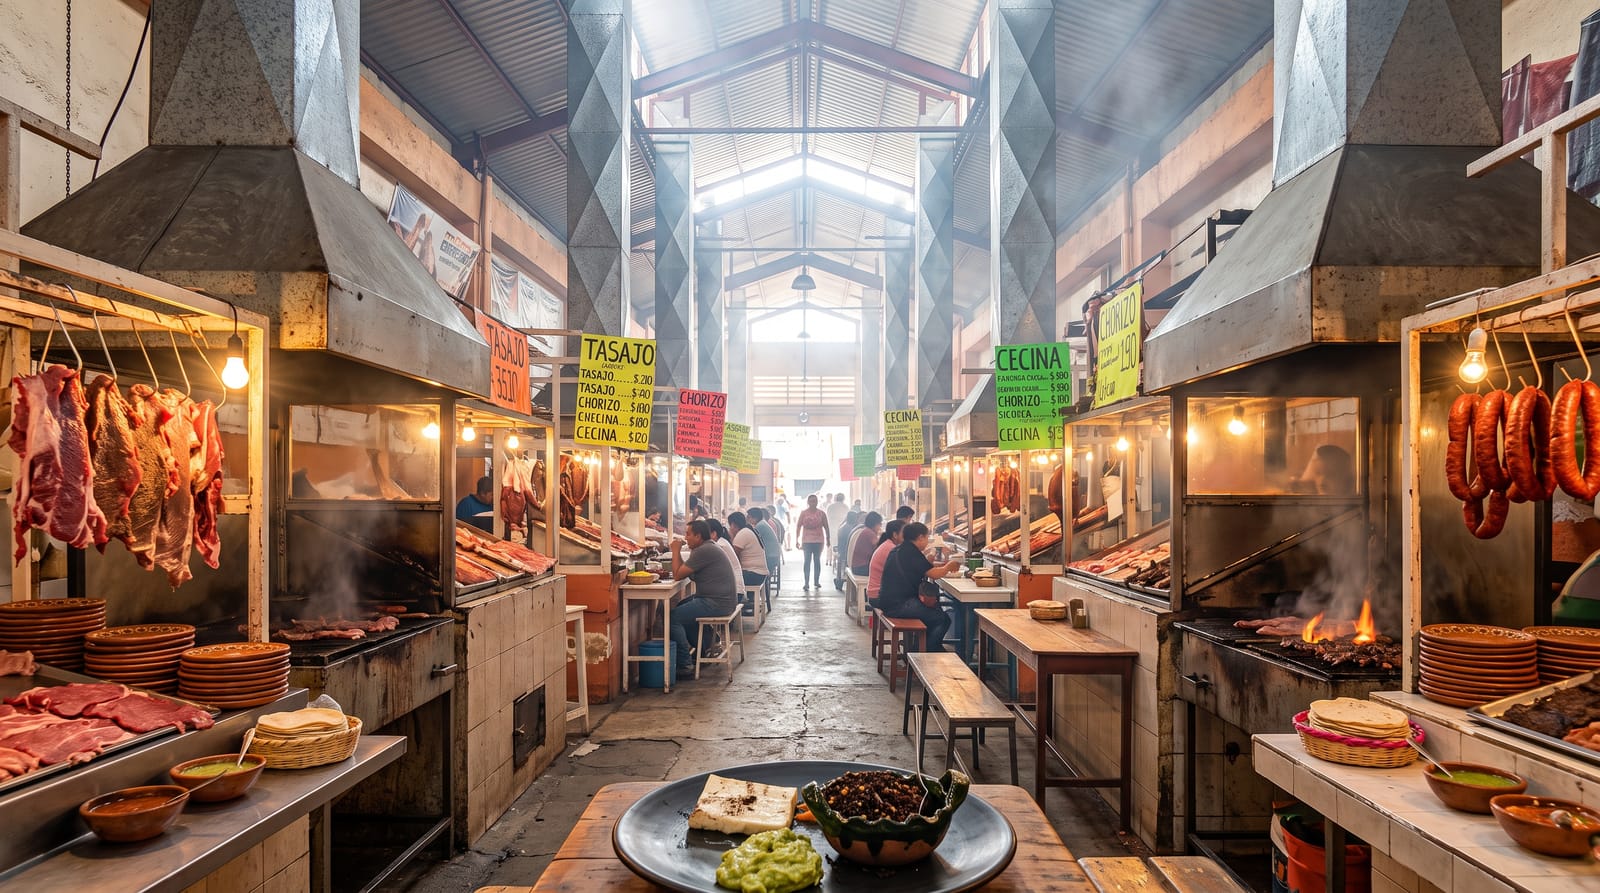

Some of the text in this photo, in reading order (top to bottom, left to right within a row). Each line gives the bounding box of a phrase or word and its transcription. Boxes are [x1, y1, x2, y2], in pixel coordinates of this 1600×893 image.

[1100, 291, 1136, 342] CHORIZO
[486, 323, 525, 368] TASAJO
[584, 338, 655, 366] TASAJO
[1120, 332, 1137, 372] 190
[997, 346, 1063, 371] CECINA
[580, 369, 614, 382] TASAJO
[579, 382, 615, 396] TASAJO
[578, 396, 620, 412] CHORIZO
[679, 391, 725, 409] CHORIZO
[998, 394, 1041, 408] CHORIZO
[885, 410, 920, 424] CECINA
[577, 425, 617, 442] CECINA
[999, 427, 1040, 442] CECINA
